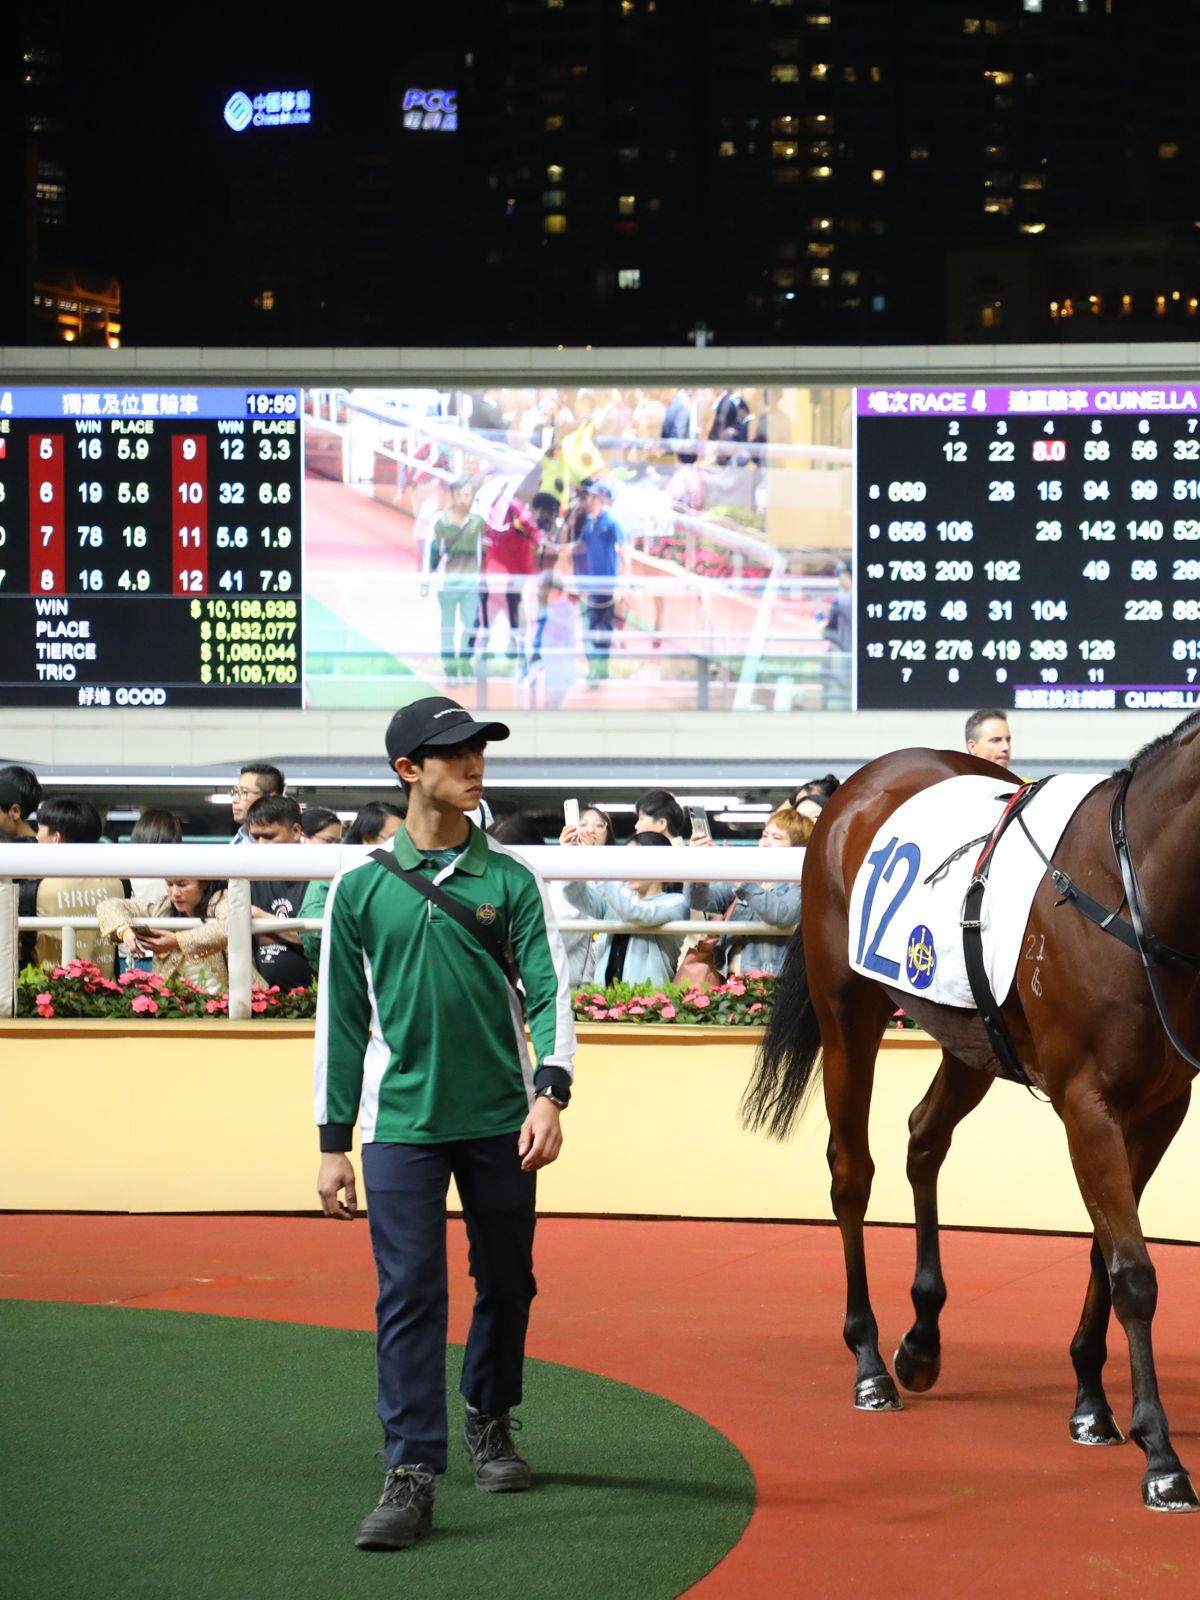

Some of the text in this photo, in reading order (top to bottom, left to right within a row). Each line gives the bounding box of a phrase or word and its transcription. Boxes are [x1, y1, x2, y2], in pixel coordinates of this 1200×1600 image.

[247, 393, 297, 415] 19:59
[1095, 390, 1199, 412] QUINELLA
[76, 420, 296, 434] WIN PLACE WIN PLACE
[40, 439, 290, 460] 5 16 5.9 9 12 3.3
[943, 442, 967, 461] 12
[989, 441, 1014, 461] 22
[1033, 441, 1065, 461] 8.0
[1084, 441, 1110, 460] 58
[1132, 440, 1157, 460] 56
[40, 482, 291, 503] 6 19 5.6 10 32 6.6
[868, 484, 880, 499] 8
[888, 482, 926, 502] 669
[989, 481, 1015, 501] 26
[1037, 481, 1062, 501] 15
[1084, 480, 1110, 500] 94
[1131, 480, 1157, 500] 99
[41, 526, 291, 547] 7 78 18 11 5.6 1.9
[868, 524, 880, 539] 9
[888, 521, 926, 542] 656
[937, 521, 973, 541] 106
[1036, 521, 1062, 541] 26
[1079, 521, 1115, 540] 142
[1127, 520, 1163, 540] 140
[41, 570, 291, 591] 8 16 4.9 12 41 7.9
[36, 599, 68, 615] WIN
[190, 599, 202, 620] $
[37, 621, 89, 637] PLACE
[200, 621, 212, 641] $
[36, 643, 96, 659] TIERCE
[200, 642, 212, 663] $
[36, 664, 76, 680] TRIO
[200, 664, 212, 684] $
[115, 688, 166, 706] GOOD
[855, 836, 921, 981] 12
